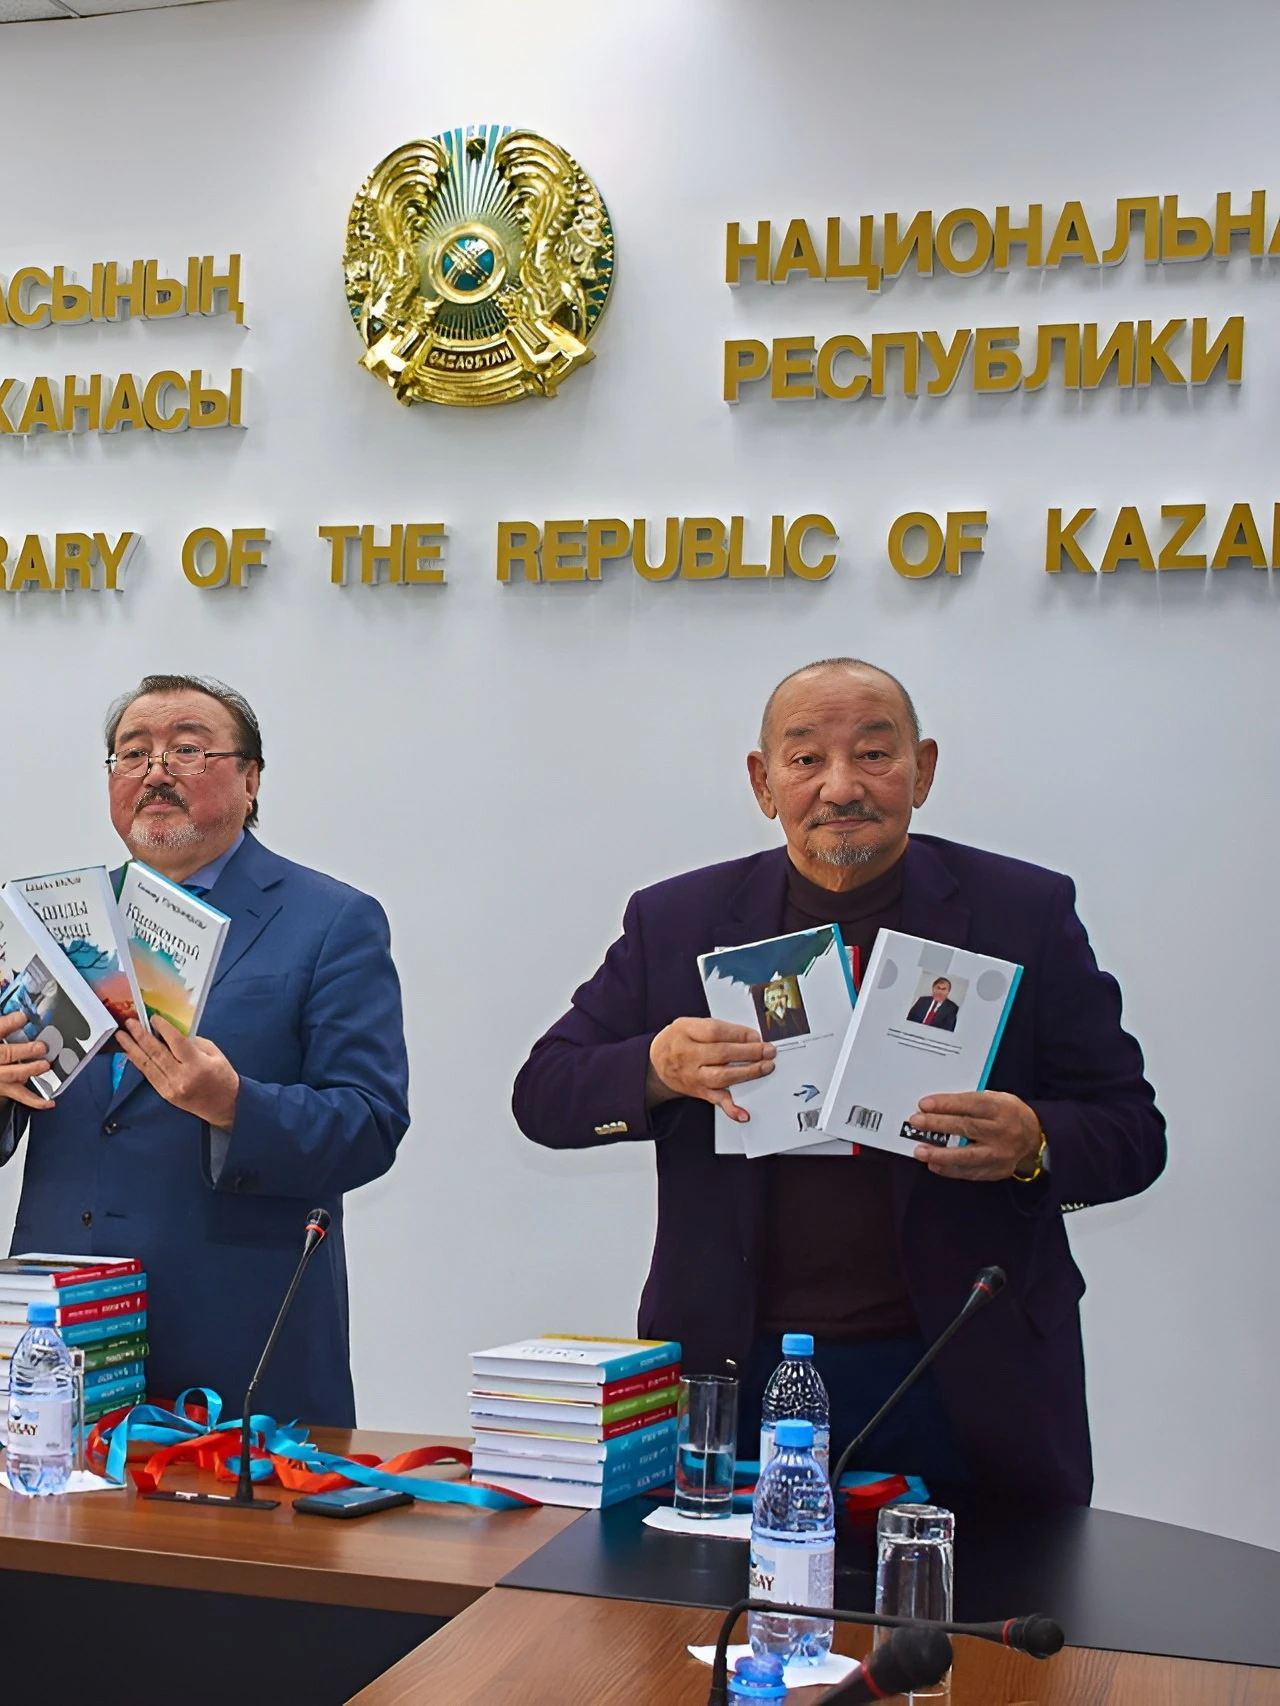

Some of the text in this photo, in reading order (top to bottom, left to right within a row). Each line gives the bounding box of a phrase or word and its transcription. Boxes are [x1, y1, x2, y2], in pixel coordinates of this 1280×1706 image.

[724, 189, 1280, 291] НАЦИОНАЛЬН
[723, 316, 1245, 401] РЕСПУБЛИКИ
[181, 527, 266, 588] OF
[318, 523, 446, 585] THE
[496, 513, 838, 581] REPUBLIC
[887, 511, 988, 579] OF
[1045, 502, 1280, 573] KAZA
